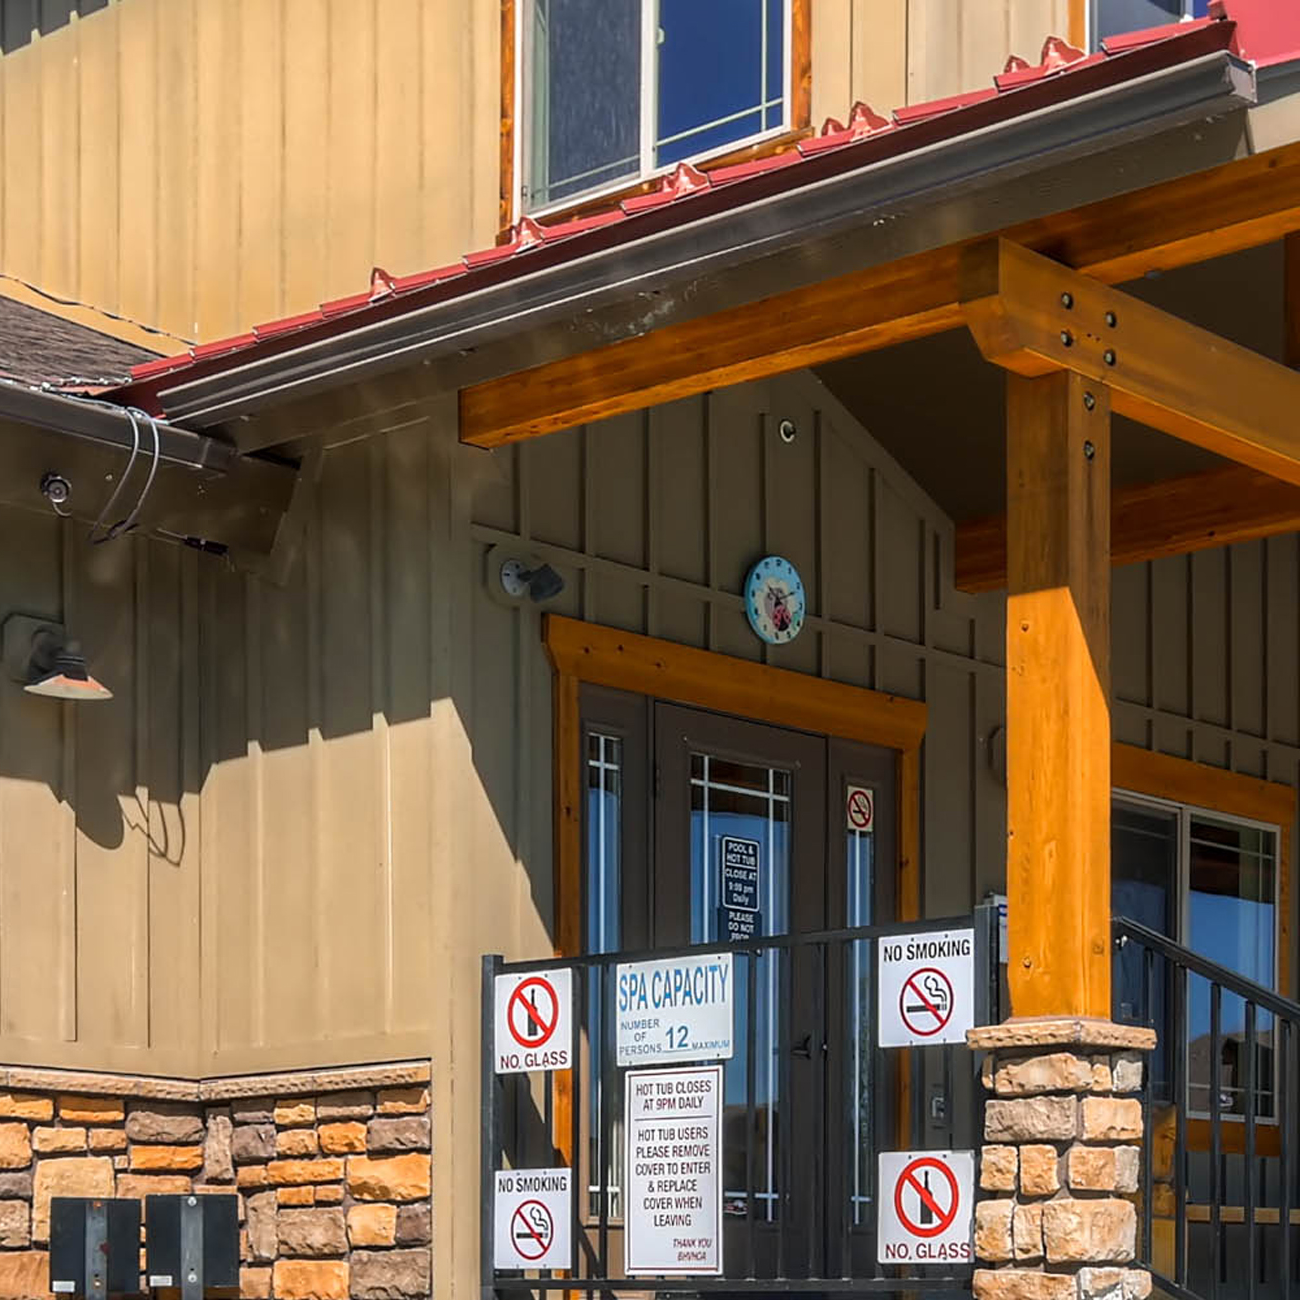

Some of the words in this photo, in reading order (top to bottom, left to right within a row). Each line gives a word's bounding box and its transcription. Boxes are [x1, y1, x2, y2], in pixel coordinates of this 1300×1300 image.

[728, 911, 754, 923] PLEASE
[884, 944, 902, 962] NO
[906, 939, 970, 960] SMOKING
[619, 972, 648, 1012] SPA
[652, 964, 729, 1009] CAPACITY
[621, 1019, 660, 1031] NUMBER
[634, 1032, 646, 1042] OF
[666, 1025, 689, 1049] 12
[619, 1043, 662, 1056] PERSONS
[692, 1039, 730, 1051] MAXIMUM
[501, 1054, 519, 1069] NO
[524, 1050, 568, 1068] GLASS
[635, 1082, 654, 1096] HOT
[655, 1081, 674, 1095] TUB
[675, 1079, 712, 1094] CLOSES
[642, 1098, 654, 1111] AT
[655, 1097, 676, 1110] 9PM
[678, 1095, 704, 1110] DAILY
[637, 1128, 656, 1142] HOT
[657, 1127, 676, 1141] TUB
[677, 1126, 709, 1141] USERS
[635, 1145, 670, 1159] PLEASE
[671, 1143, 710, 1158] REMOVE
[635, 1162, 665, 1176] COVER
[666, 1162, 678, 1175] TO
[680, 1160, 711, 1175] ENTER
[499, 1178, 514, 1193] NO
[516, 1176, 567, 1192] SMOKING
[647, 1180, 655, 1193] &
[657, 1178, 697, 1193] REPLACE
[643, 1196, 673, 1210] COVER
[674, 1195, 703, 1209] WHEN
[653, 1213, 692, 1227] LEAVING
[885, 1243, 909, 1259] NO
[916, 1242, 971, 1259] GLASS
